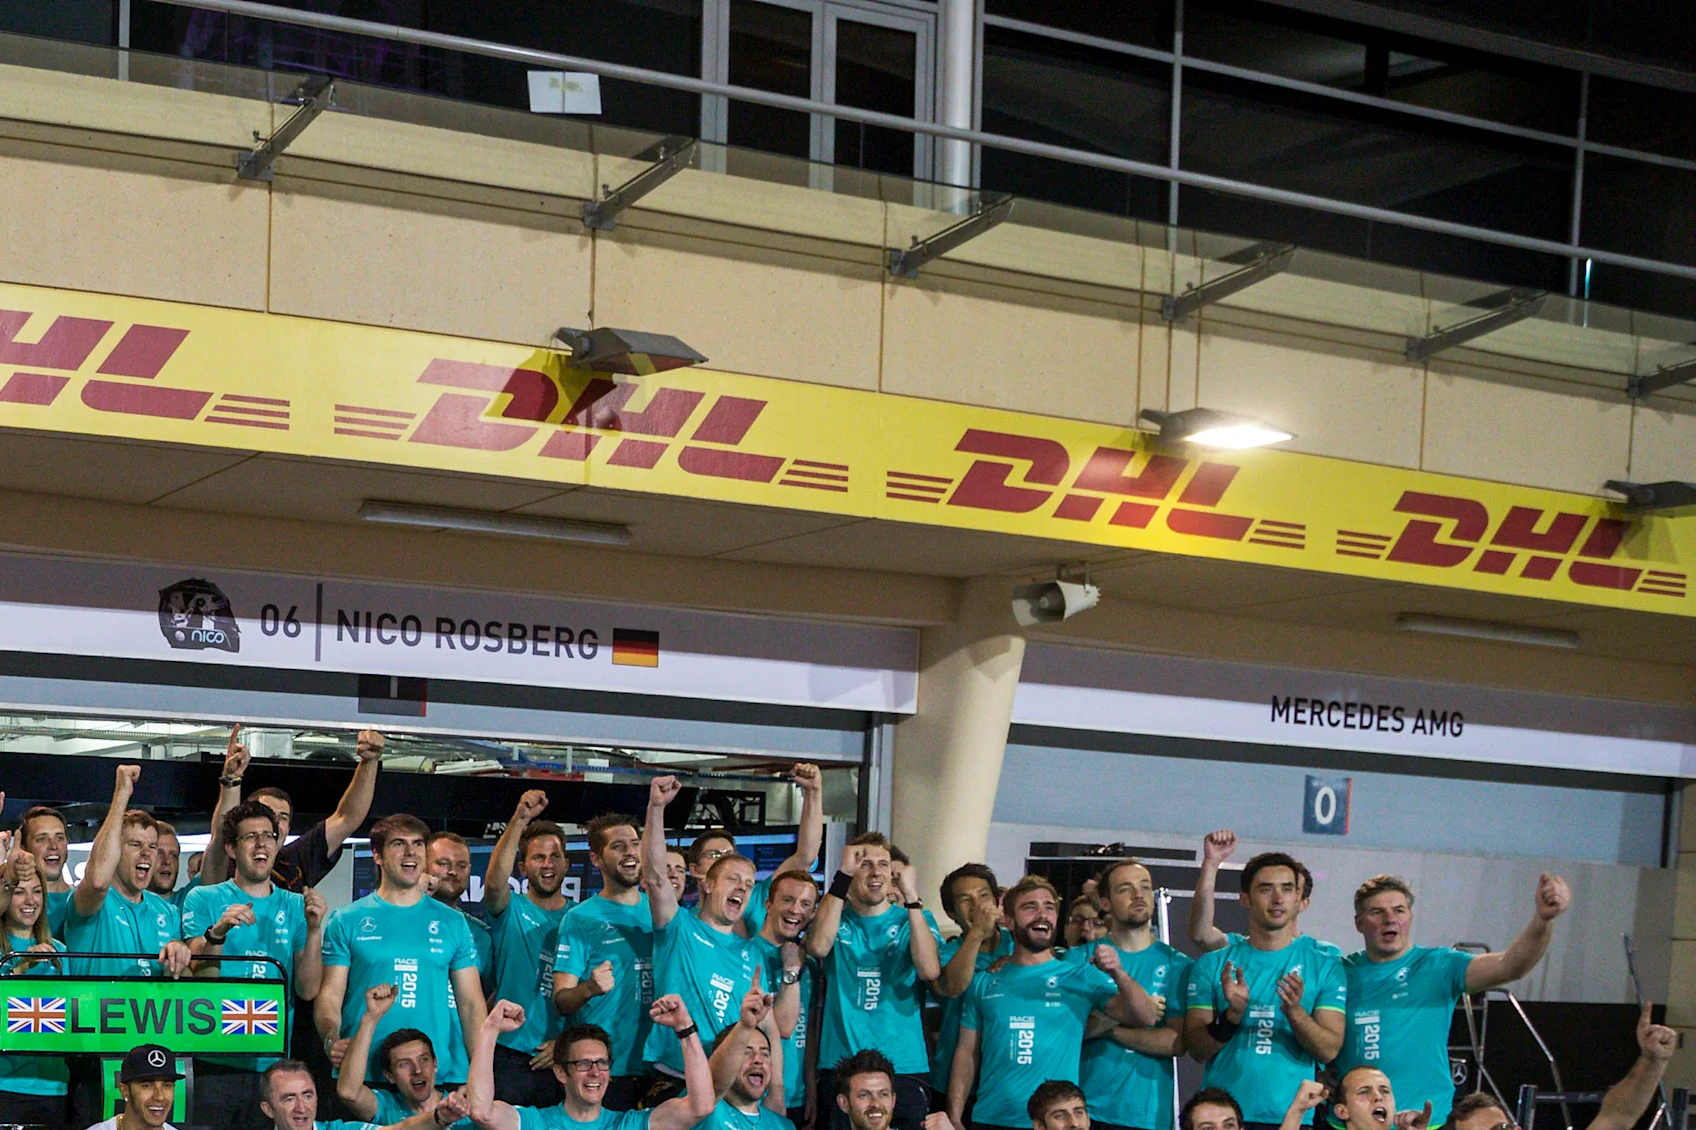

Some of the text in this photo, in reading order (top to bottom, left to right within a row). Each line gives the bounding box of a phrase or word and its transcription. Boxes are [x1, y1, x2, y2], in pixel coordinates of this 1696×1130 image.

[408, 358, 786, 483] DHL
[947, 428, 1255, 541] DHL
[1386, 490, 1643, 589] DHL
[260, 603, 302, 638] 06
[336, 609, 599, 660] NICO ROSBERG
[1271, 695, 1465, 737] MERCEDES AMG
[1314, 785, 1337, 825] 0
[394, 958, 418, 966] RACE
[401, 972, 418, 1009] 2015
[641, 970, 653, 1005] 2015
[864, 978, 881, 1011] 2015
[71, 997, 217, 1035] LEWIS
[713, 990, 731, 1024] 201
[1017, 1030, 1035, 1065] 2015
[1256, 1019, 1274, 1055] 2015
[1364, 1025, 1381, 1060] 2015
